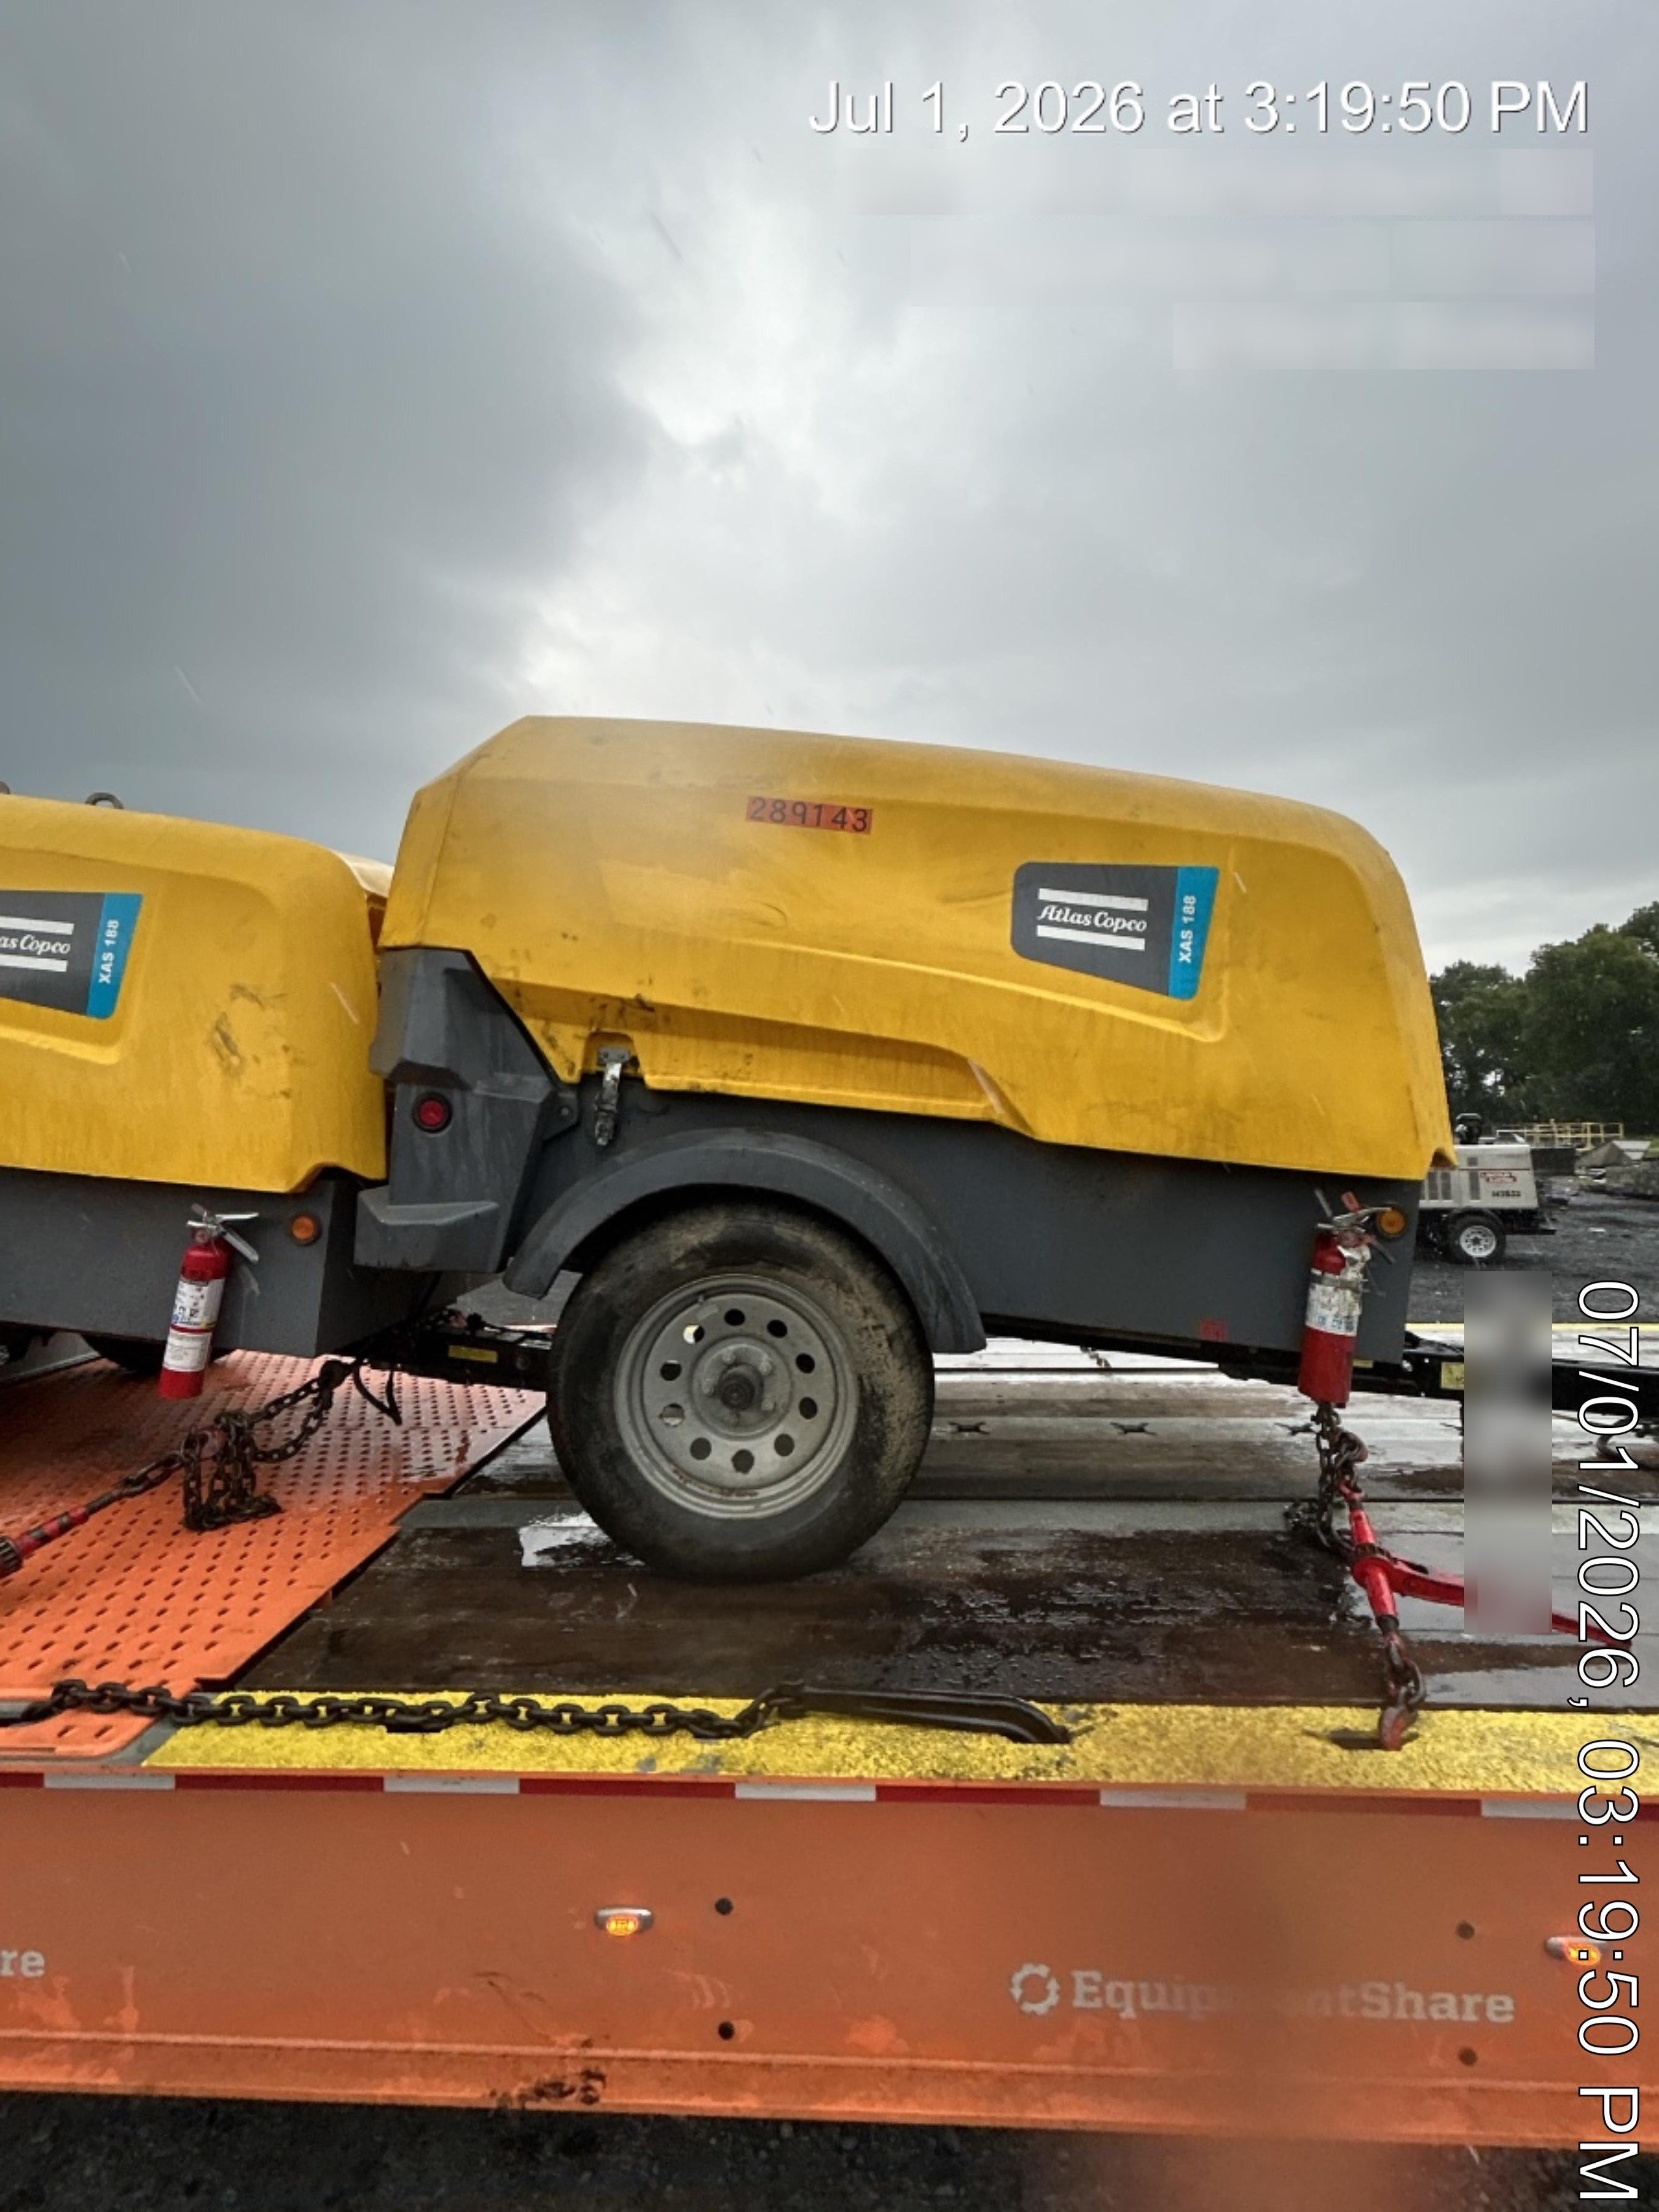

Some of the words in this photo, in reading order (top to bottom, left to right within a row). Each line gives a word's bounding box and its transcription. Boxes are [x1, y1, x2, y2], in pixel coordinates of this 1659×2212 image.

[749, 797, 868, 833] 289143
[1037, 904, 1091, 926] Atlas
[1094, 911, 1147, 933] Copco
[1183, 895, 1198, 925] 188
[19, 934, 71, 955] Copco
[104, 919, 119, 947] 188
[1179, 929, 1194, 964] XAS
[98, 952, 115, 985] XAS
